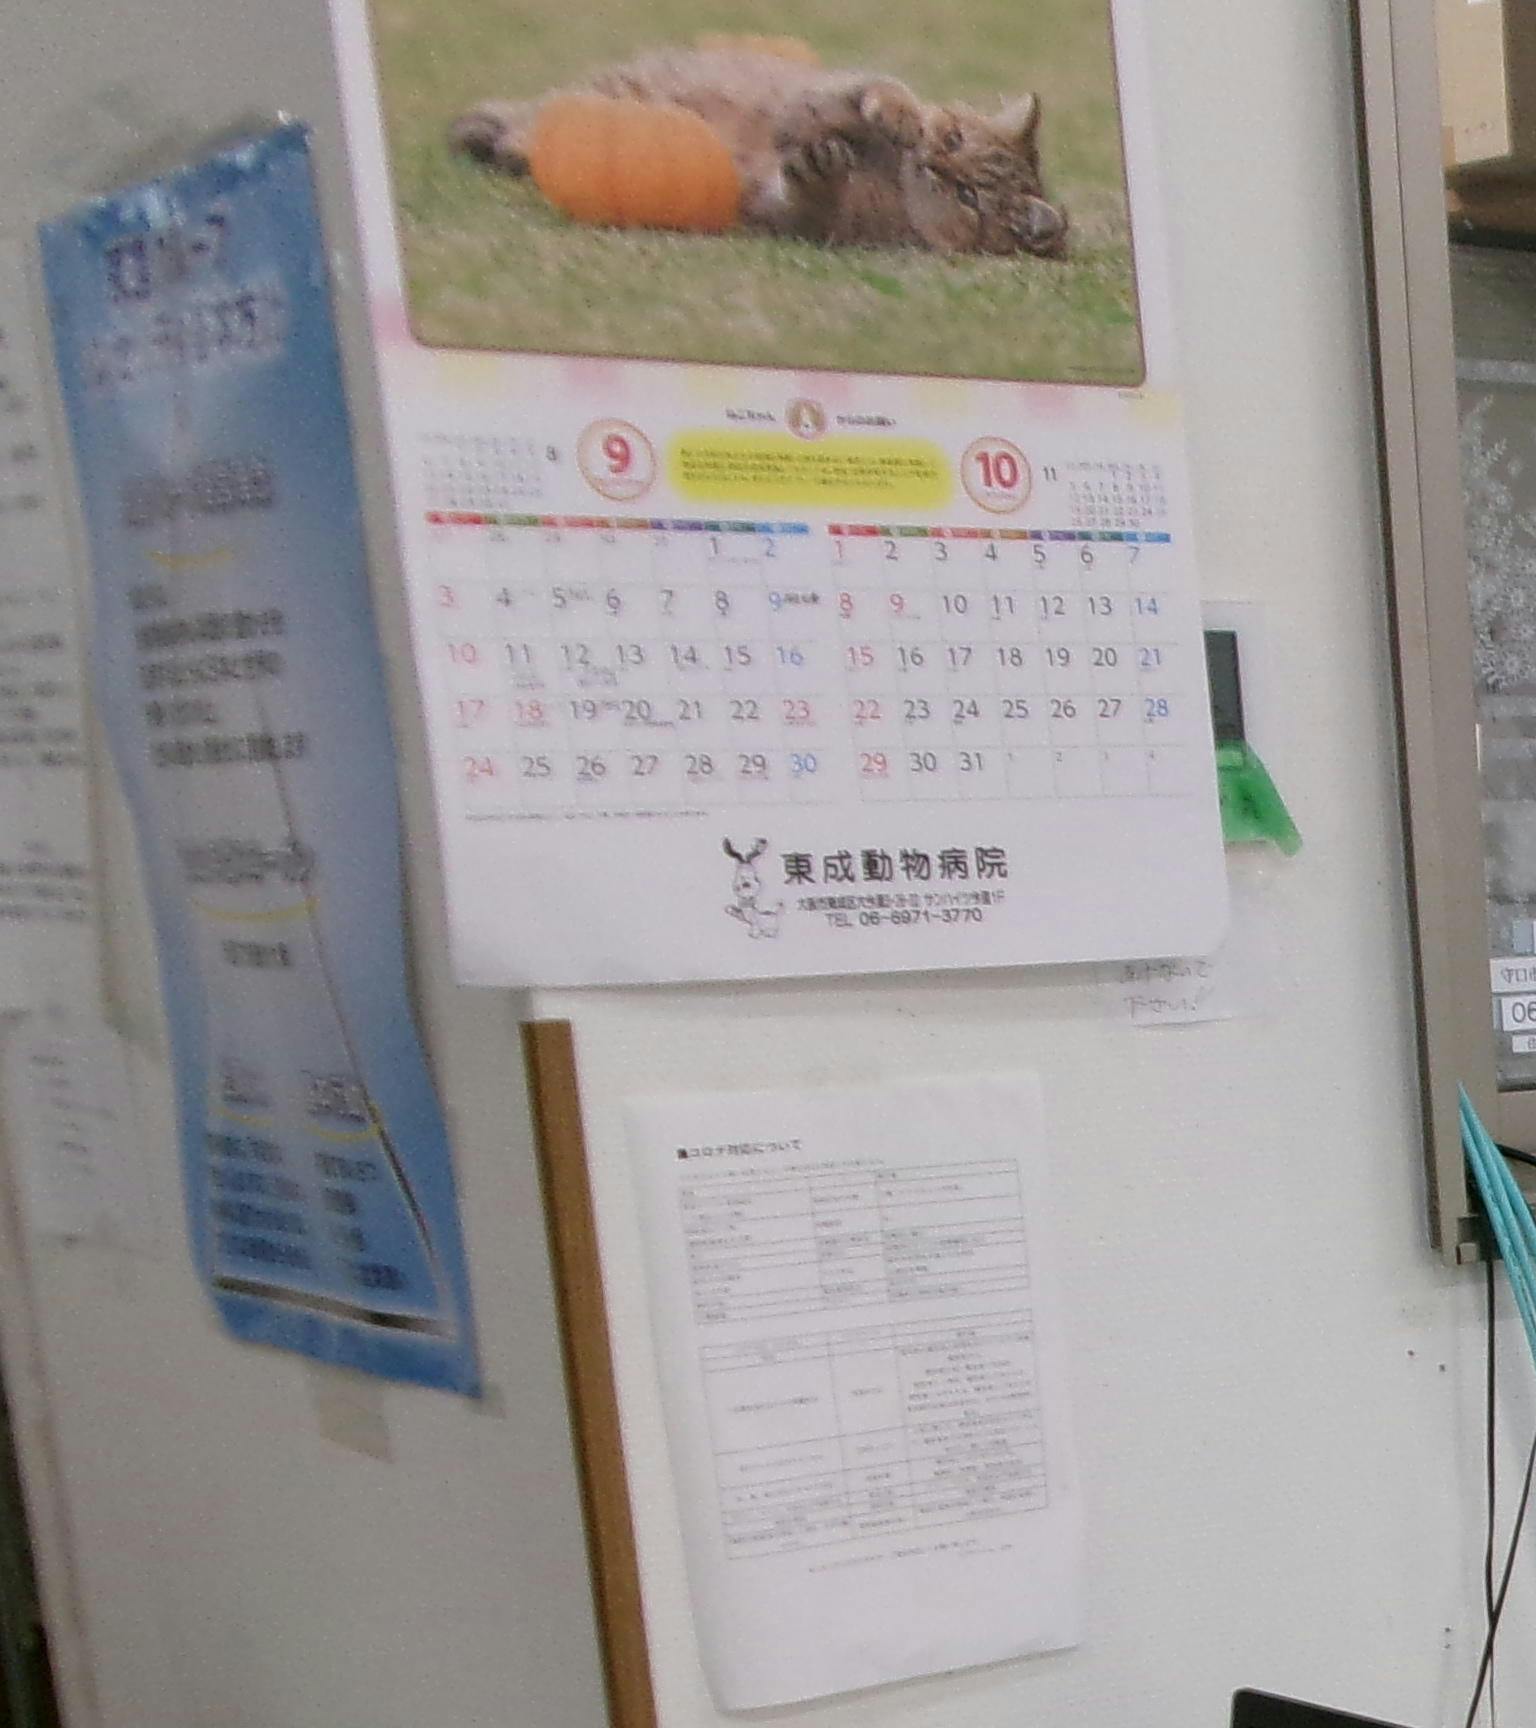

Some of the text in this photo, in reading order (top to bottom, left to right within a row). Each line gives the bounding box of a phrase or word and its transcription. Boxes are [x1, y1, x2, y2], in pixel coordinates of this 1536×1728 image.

[602, 433, 632, 474] 9
[974, 450, 1020, 490] 10
[1042, 466, 1060, 482] 11
[833, 541, 1141, 565] 1 2 3 4 5 6 7
[438, 583, 456, 607] 3
[496, 587, 512, 608] 4
[551, 586, 568, 609] 5
[606, 589, 622, 611] 6
[659, 589, 675, 610] 7
[714, 590, 731, 612] 8
[768, 591, 784, 613] 9
[838, 592, 854, 614] 8
[889, 593, 906, 613] 9
[942, 594, 968, 616] 10
[991, 594, 1016, 616] 11
[1040, 595, 1066, 616] 12
[1087, 596, 1113, 616] 13
[1135, 596, 1159, 616] 14
[447, 642, 806, 667] 10 11 12 13 14 15 16
[847, 645, 1163, 668] 15 16 17 18 19 20 21
[456, 699, 812, 722] 17 18 19 20 21 22 23
[854, 698, 1169, 721] 22 23 24 25 26 27 28
[462, 752, 818, 779] 24 25 26 27 28 29 30
[860, 751, 986, 774] 29 30 31
[780, 846, 1010, 886] 東成動物病院
[827, 907, 983, 929] TEL 06-6971-3770
